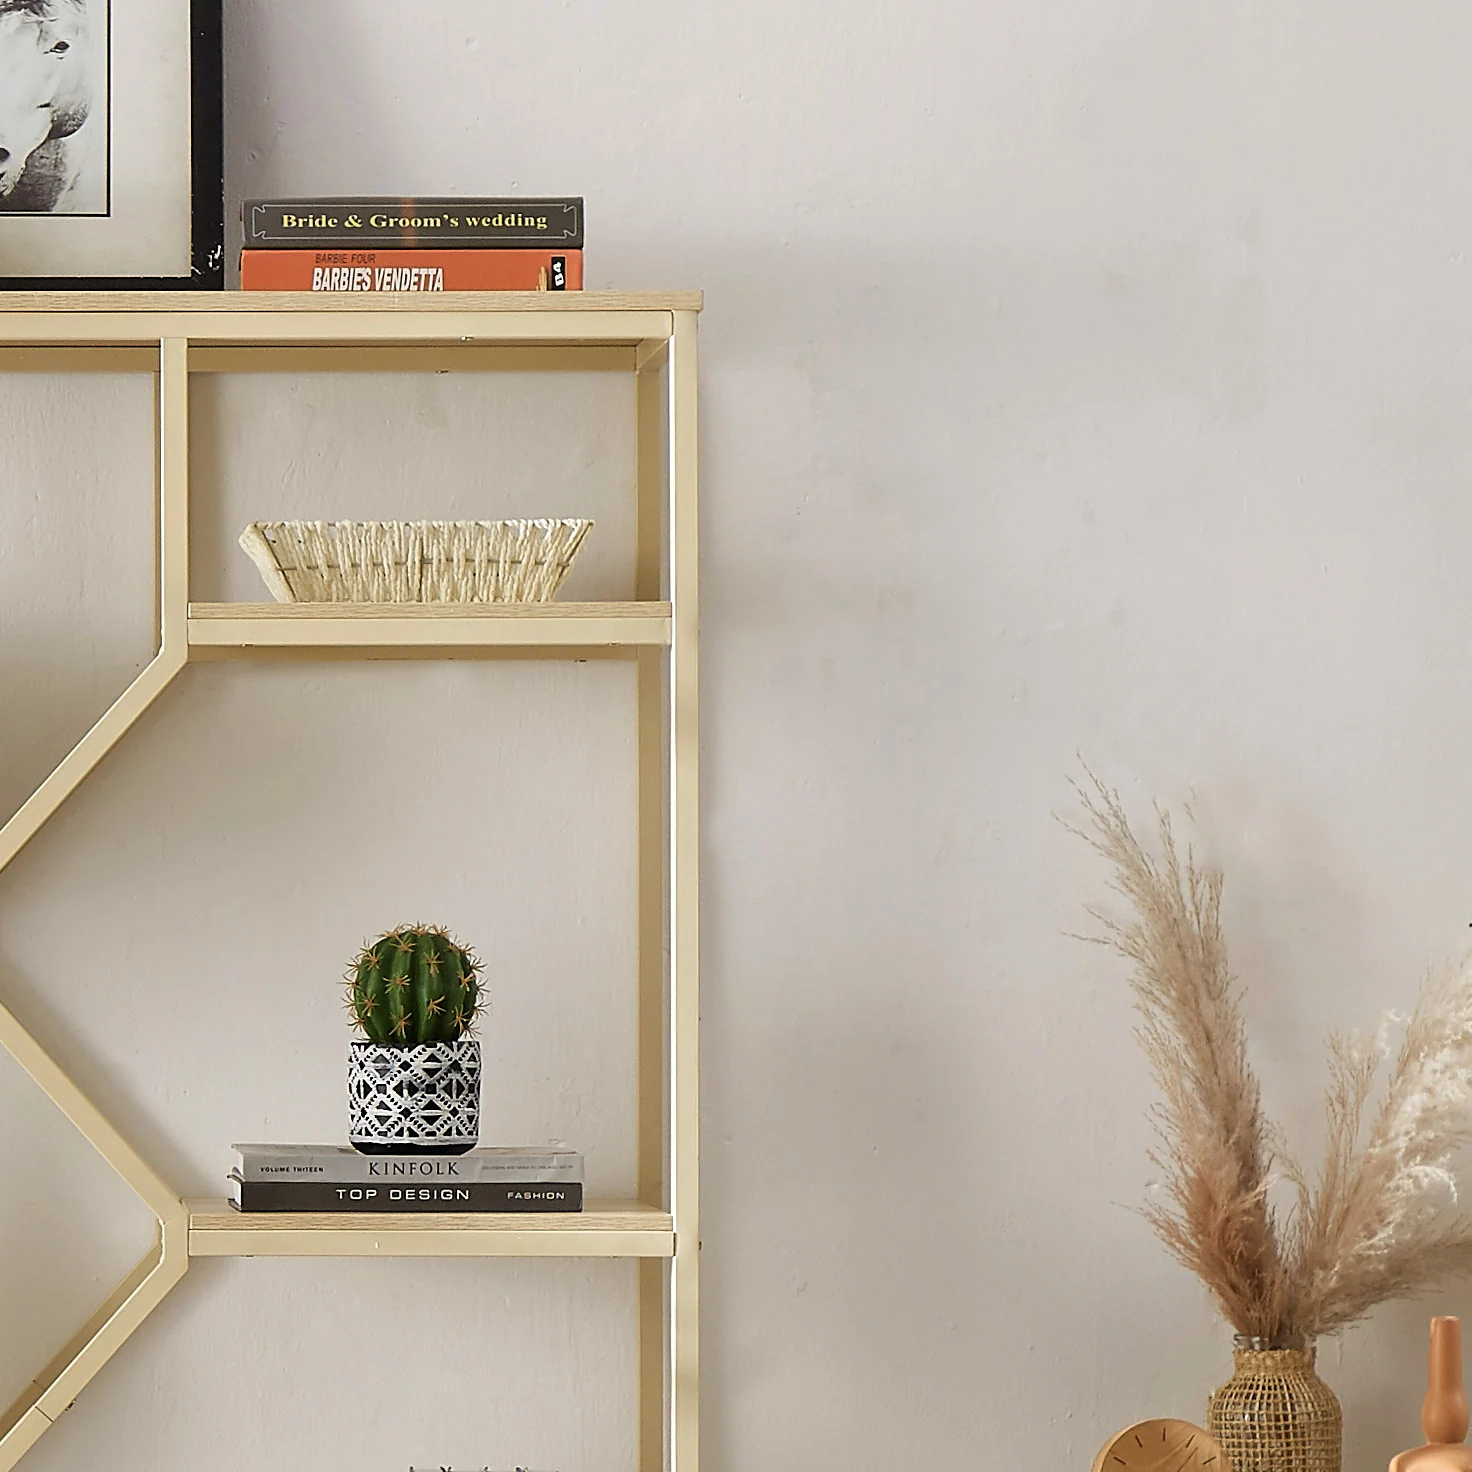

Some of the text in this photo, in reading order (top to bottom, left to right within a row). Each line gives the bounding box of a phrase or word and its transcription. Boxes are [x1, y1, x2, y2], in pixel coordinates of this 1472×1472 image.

[281, 213, 548, 230] Bride & Groom's wedding
[315, 253, 377, 264] BARBIE FOUR
[374, 267, 444, 291] VENDETTA
[368, 1161, 460, 1176] KINFOLK
[335, 1188, 470, 1201] TOP DESIGN
[507, 1191, 565, 1200] FASHION
